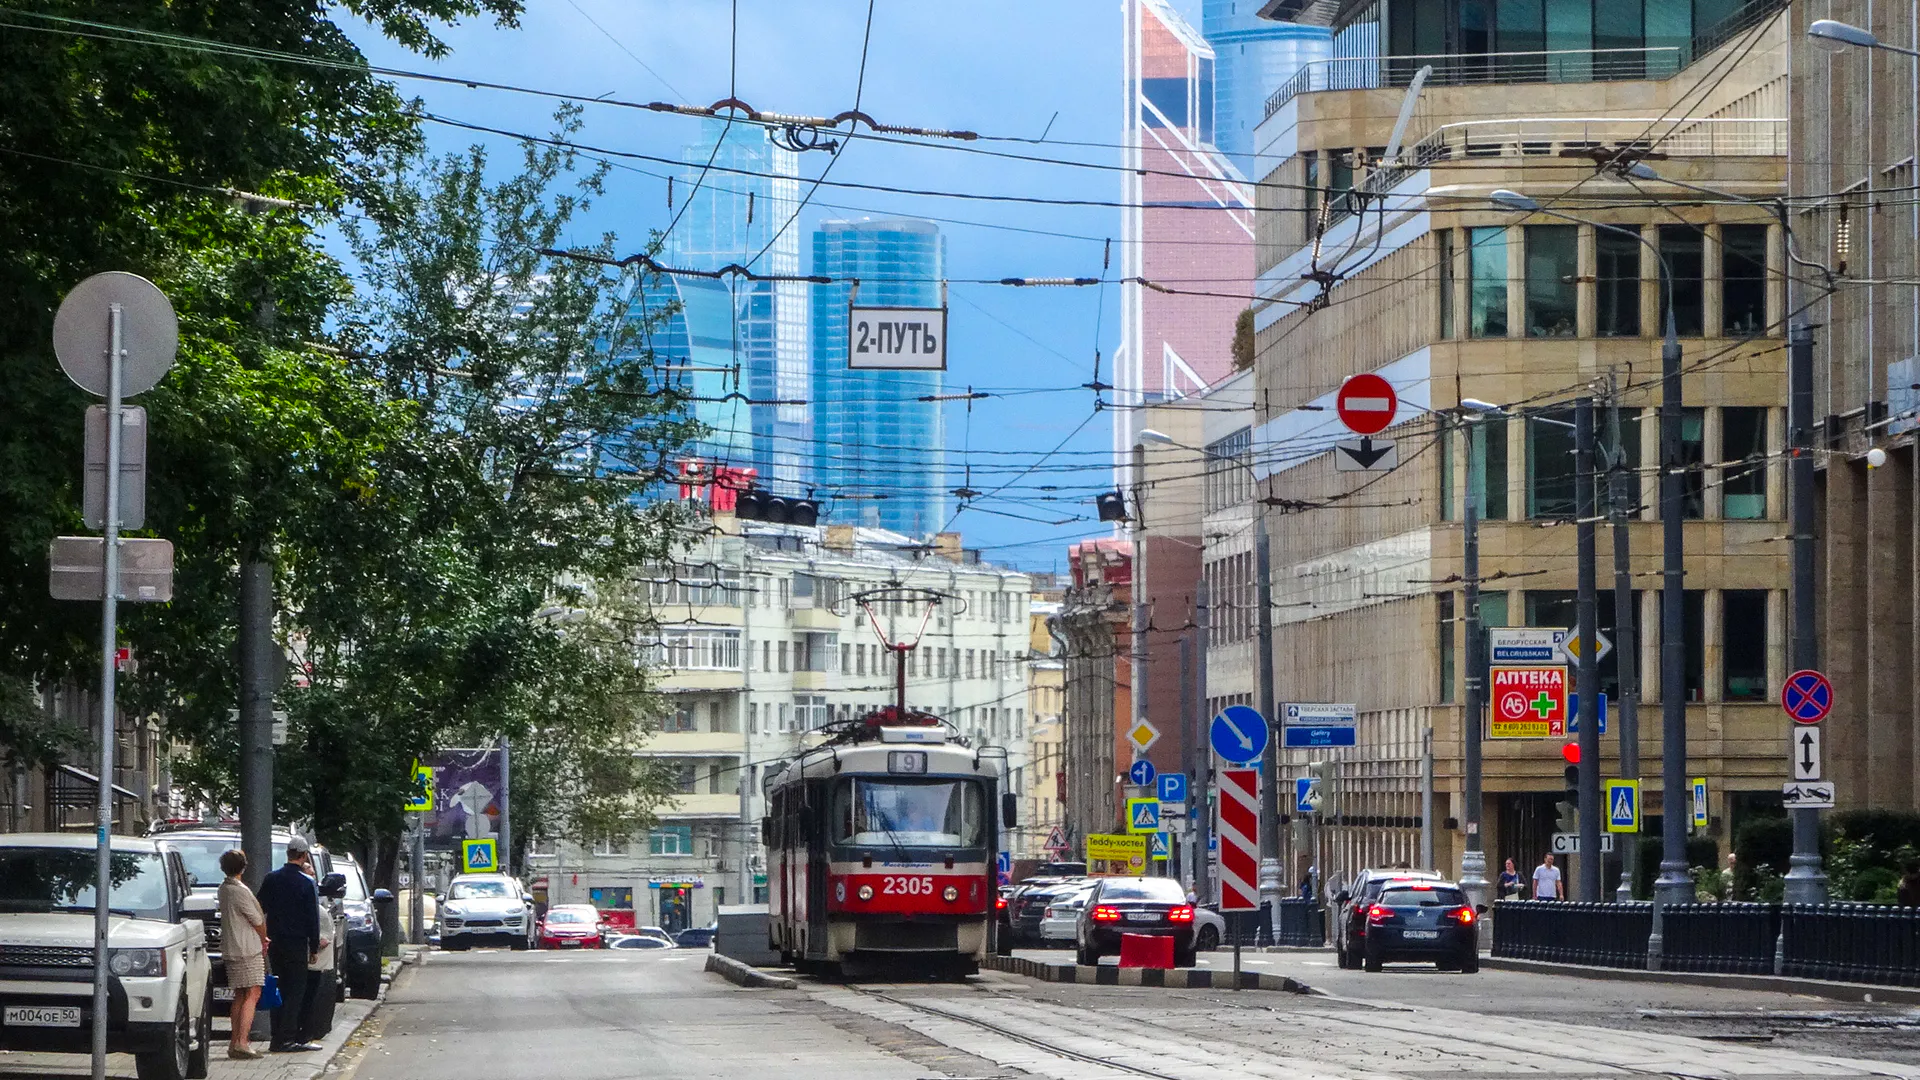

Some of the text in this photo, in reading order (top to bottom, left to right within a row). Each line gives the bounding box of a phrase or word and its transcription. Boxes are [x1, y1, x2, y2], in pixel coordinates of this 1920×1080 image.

[856, 321, 937, 354] 2-ПУТЬ
[1496, 671, 1562, 685] АПТЕКА
[903, 754, 915, 771] 9
[1165, 777, 1179, 797] P
[1554, 836, 1611, 850] СТП
[882, 877, 934, 895] 2305
[9, 1010, 75, 1022] М004ОЕ 50
